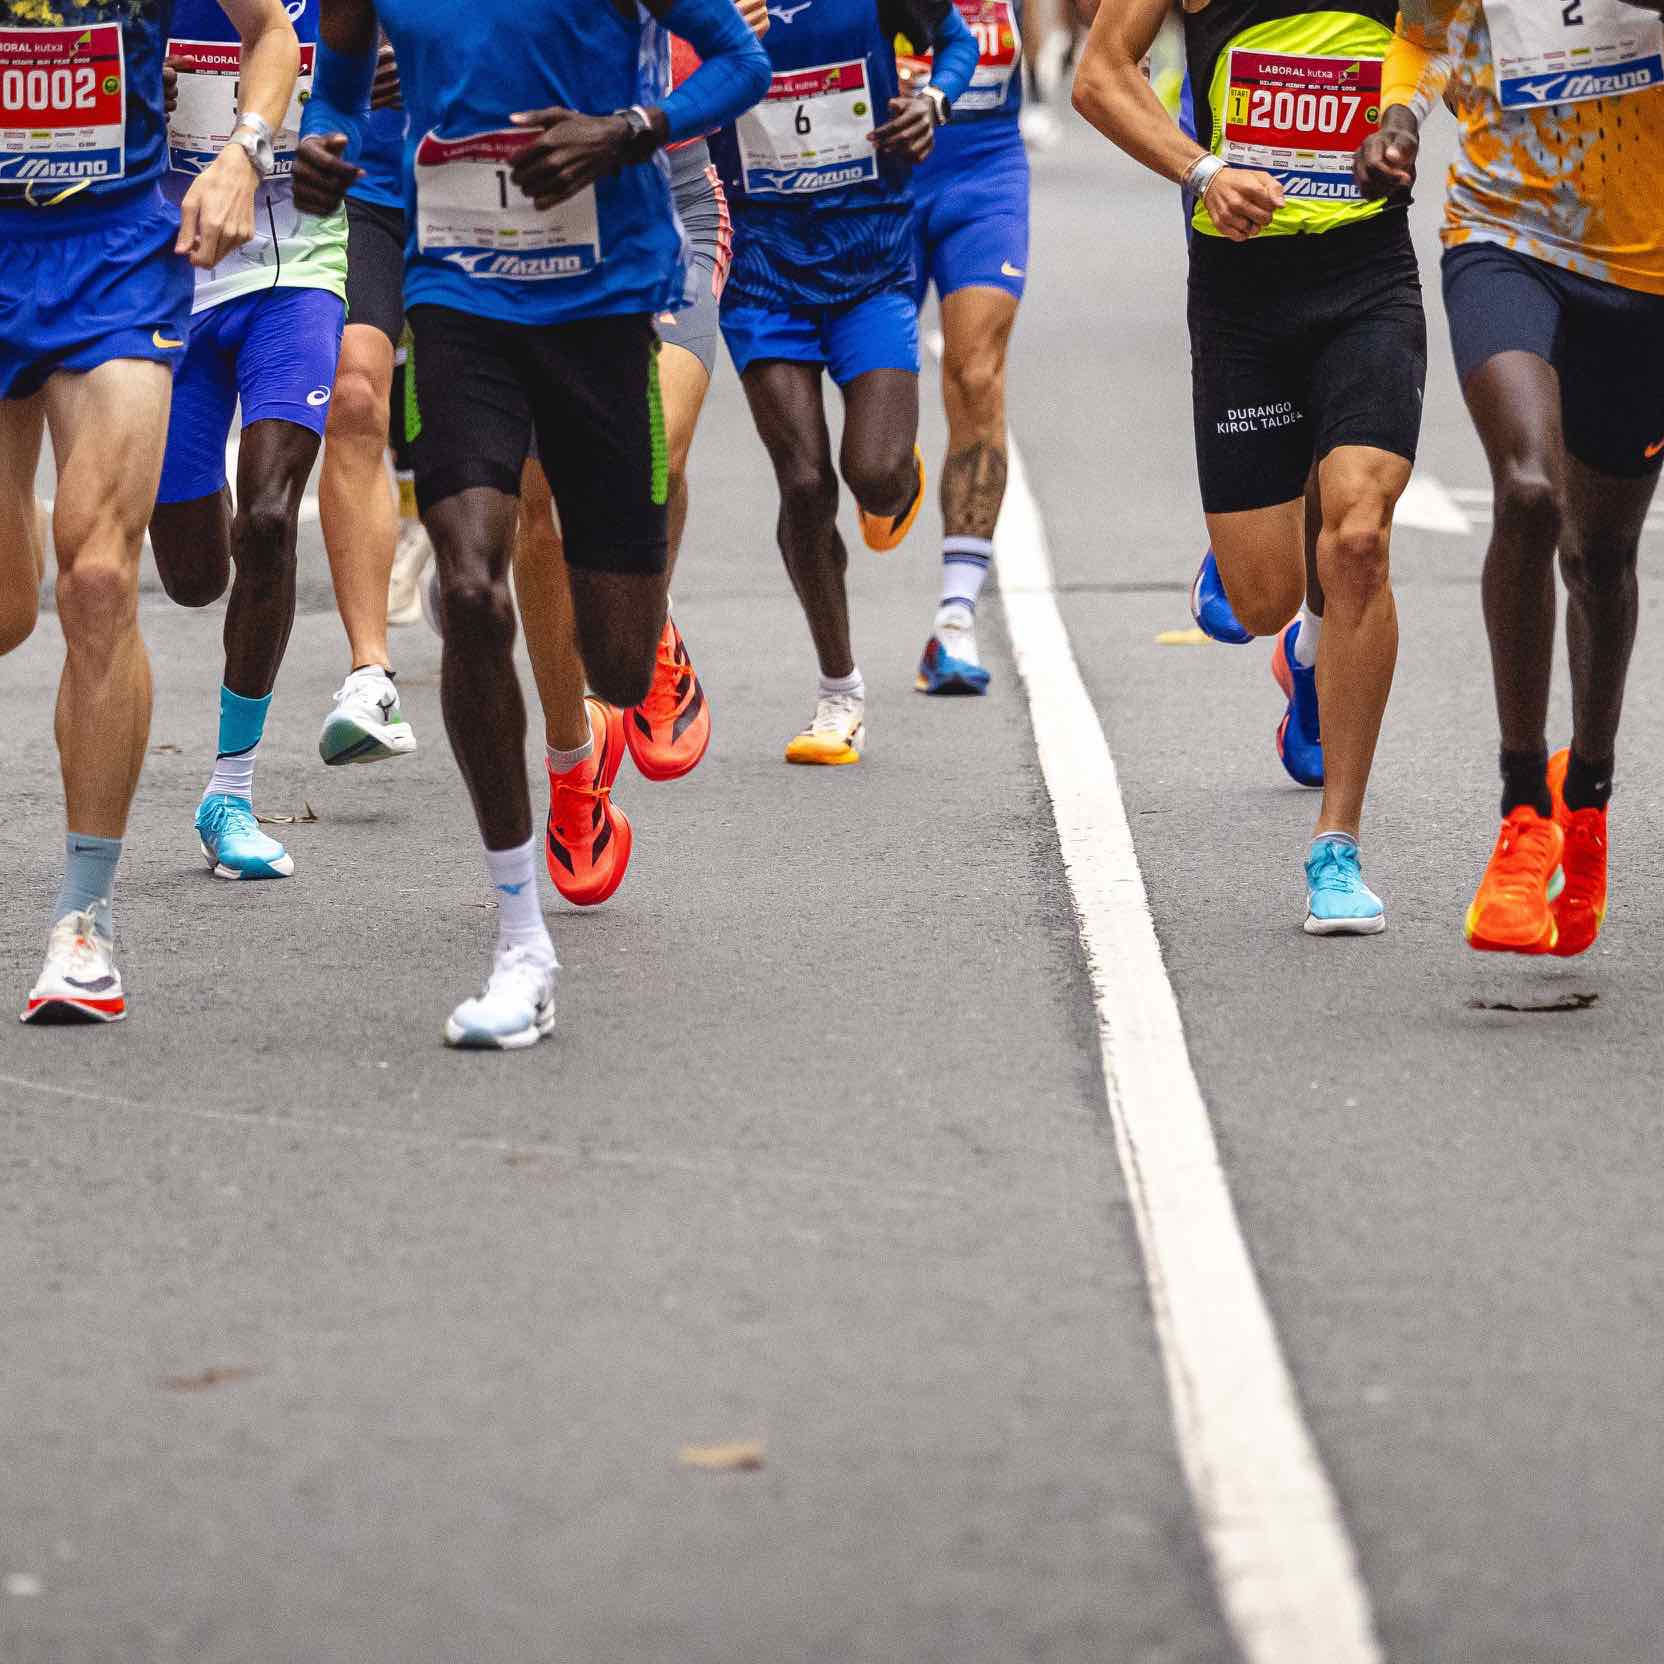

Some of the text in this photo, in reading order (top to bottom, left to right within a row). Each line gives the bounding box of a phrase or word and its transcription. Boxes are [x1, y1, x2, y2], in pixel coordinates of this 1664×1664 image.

[1259, 64, 1334, 78] LABORAL kutxa
[1231, 89, 1249, 97] START
[1235, 97, 1241, 116] 1
[1250, 90, 1362, 134] 20007
[794, 104, 811, 136] 6
[15, 159, 108, 178] MIZUNO
[495, 170, 507, 209] 1
[1227, 401, 1292, 420] DURANGO
[1216, 419, 1258, 434] KIROL
